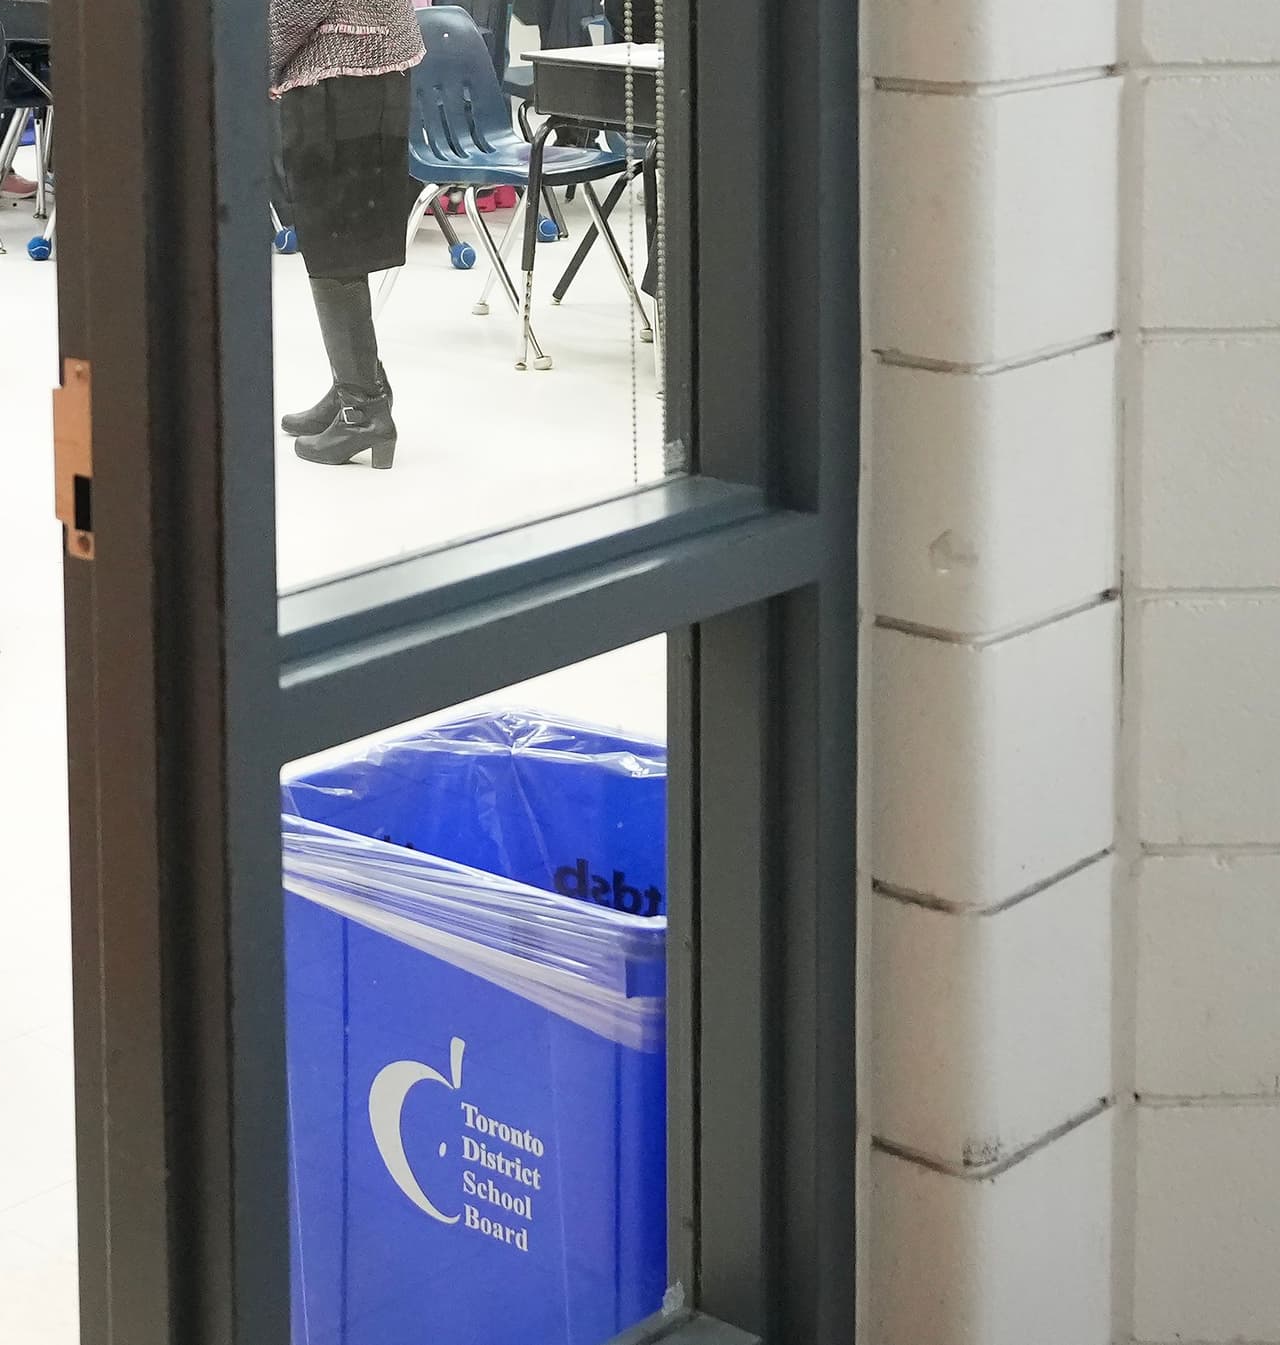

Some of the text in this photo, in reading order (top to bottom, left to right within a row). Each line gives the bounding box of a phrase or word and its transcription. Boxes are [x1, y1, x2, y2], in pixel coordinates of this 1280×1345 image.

[460, 1101, 545, 1158] Toronto
[461, 1135, 542, 1190] District
[463, 1169, 533, 1221] School
[464, 1203, 529, 1252] Board
